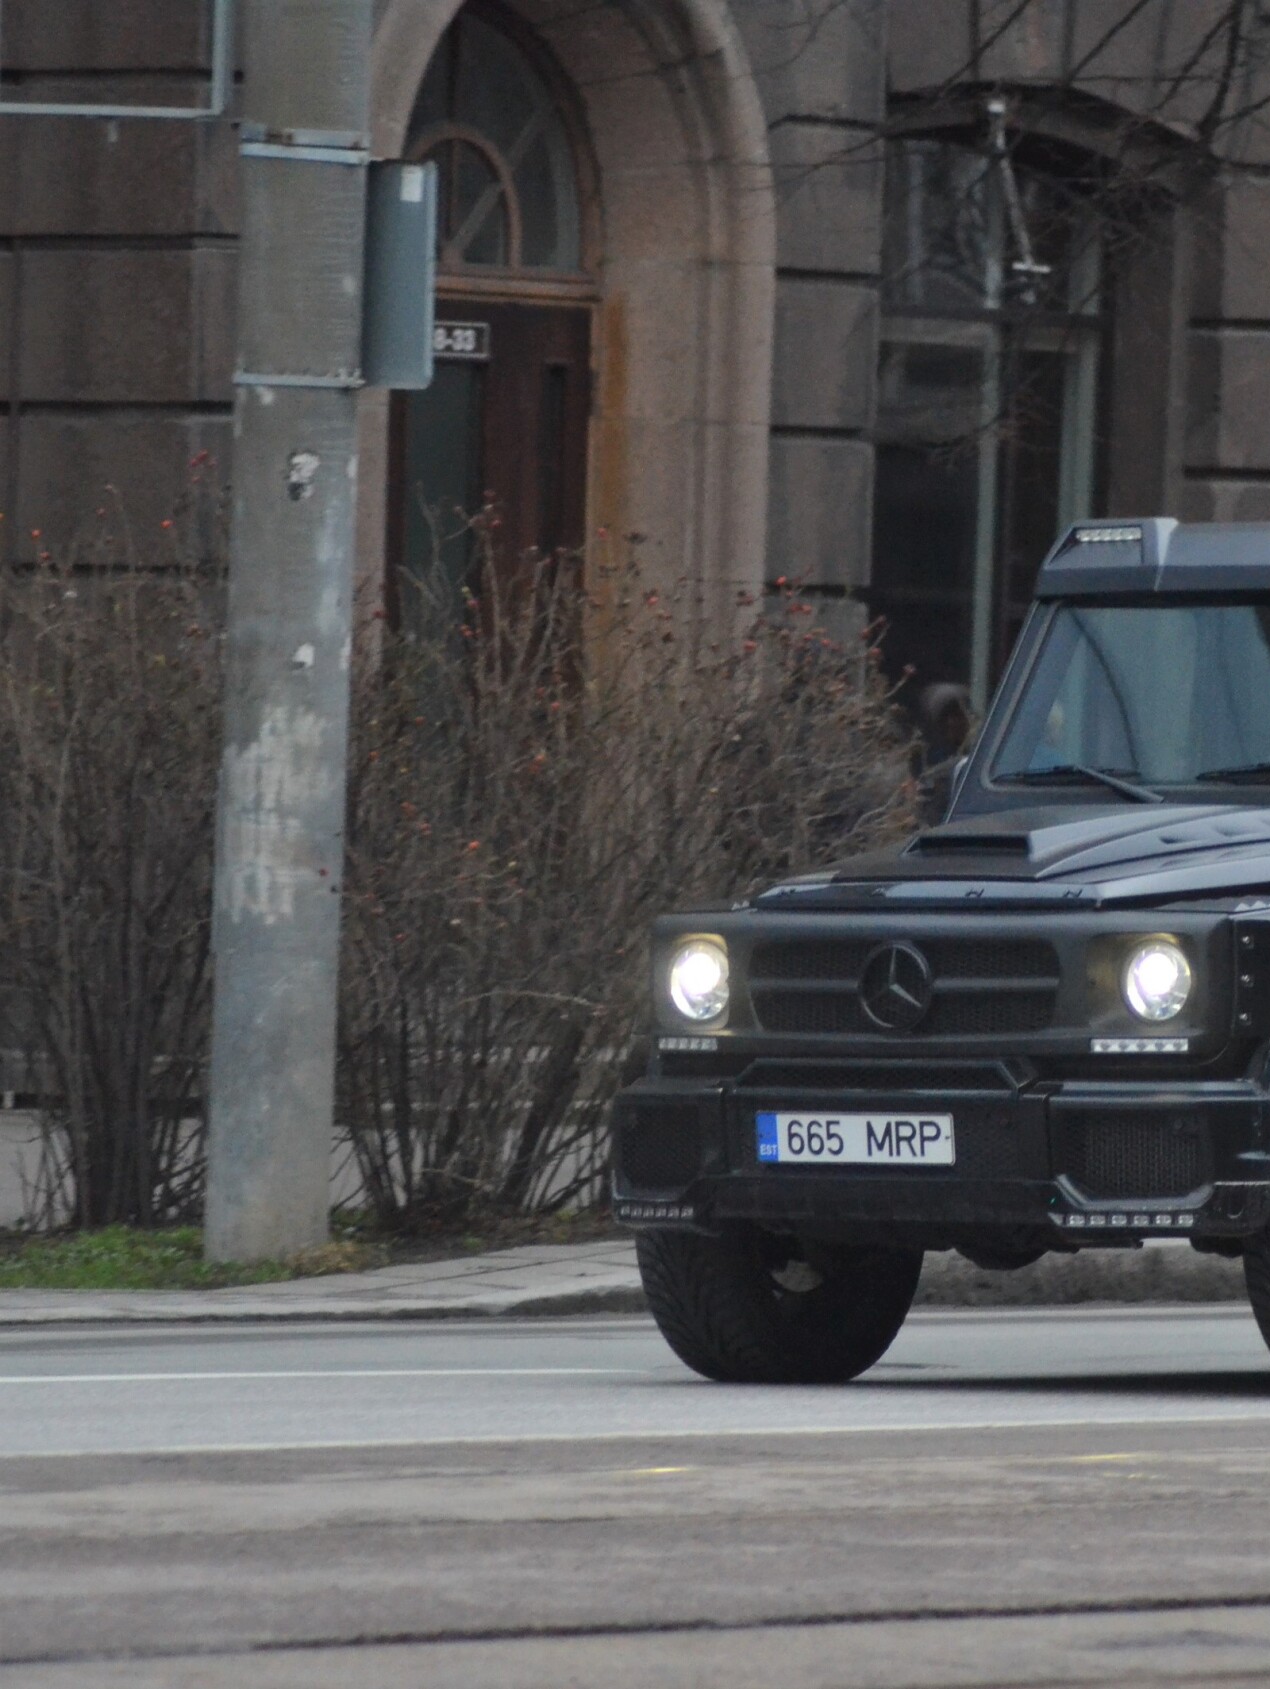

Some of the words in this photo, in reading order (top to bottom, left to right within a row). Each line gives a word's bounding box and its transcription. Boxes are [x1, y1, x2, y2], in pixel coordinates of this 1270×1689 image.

[759, 1144, 778, 1156] EST
[786, 1119, 845, 1157] 665
[865, 1120, 942, 1158] MRP
